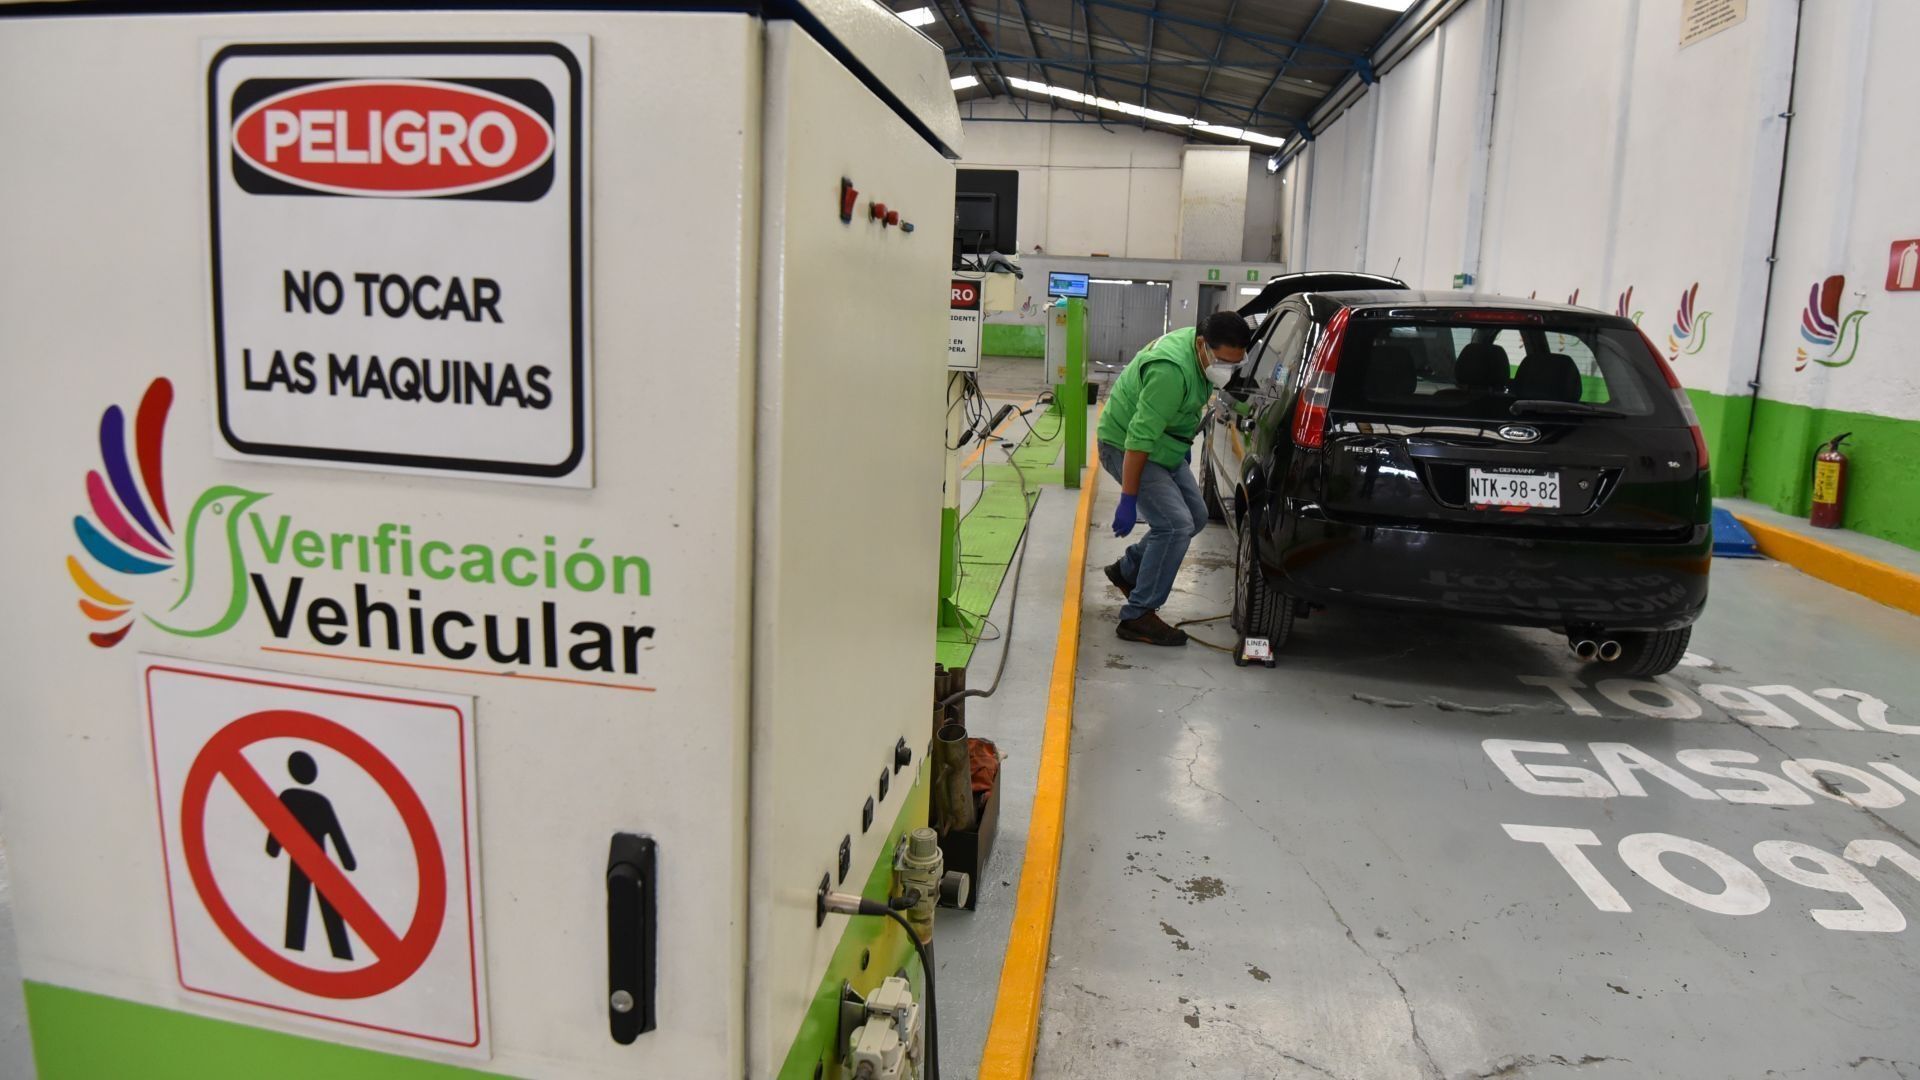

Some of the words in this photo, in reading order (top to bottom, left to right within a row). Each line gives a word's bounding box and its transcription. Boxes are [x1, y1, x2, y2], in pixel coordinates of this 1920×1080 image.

[263, 109, 518, 167] PELIGRO
[283, 269, 344, 315] NO
[355, 272, 503, 324] TOCAR
[242, 347, 316, 394] LAS
[328, 355, 553, 411] MAQUINAS
[1343, 445, 1390, 455] FIESTA
[1499, 467, 1536, 475] GERMANY
[1471, 478, 1558, 500] NTK-98-82
[249, 512, 652, 596] Verificación
[250, 572, 656, 675] Vehicular
